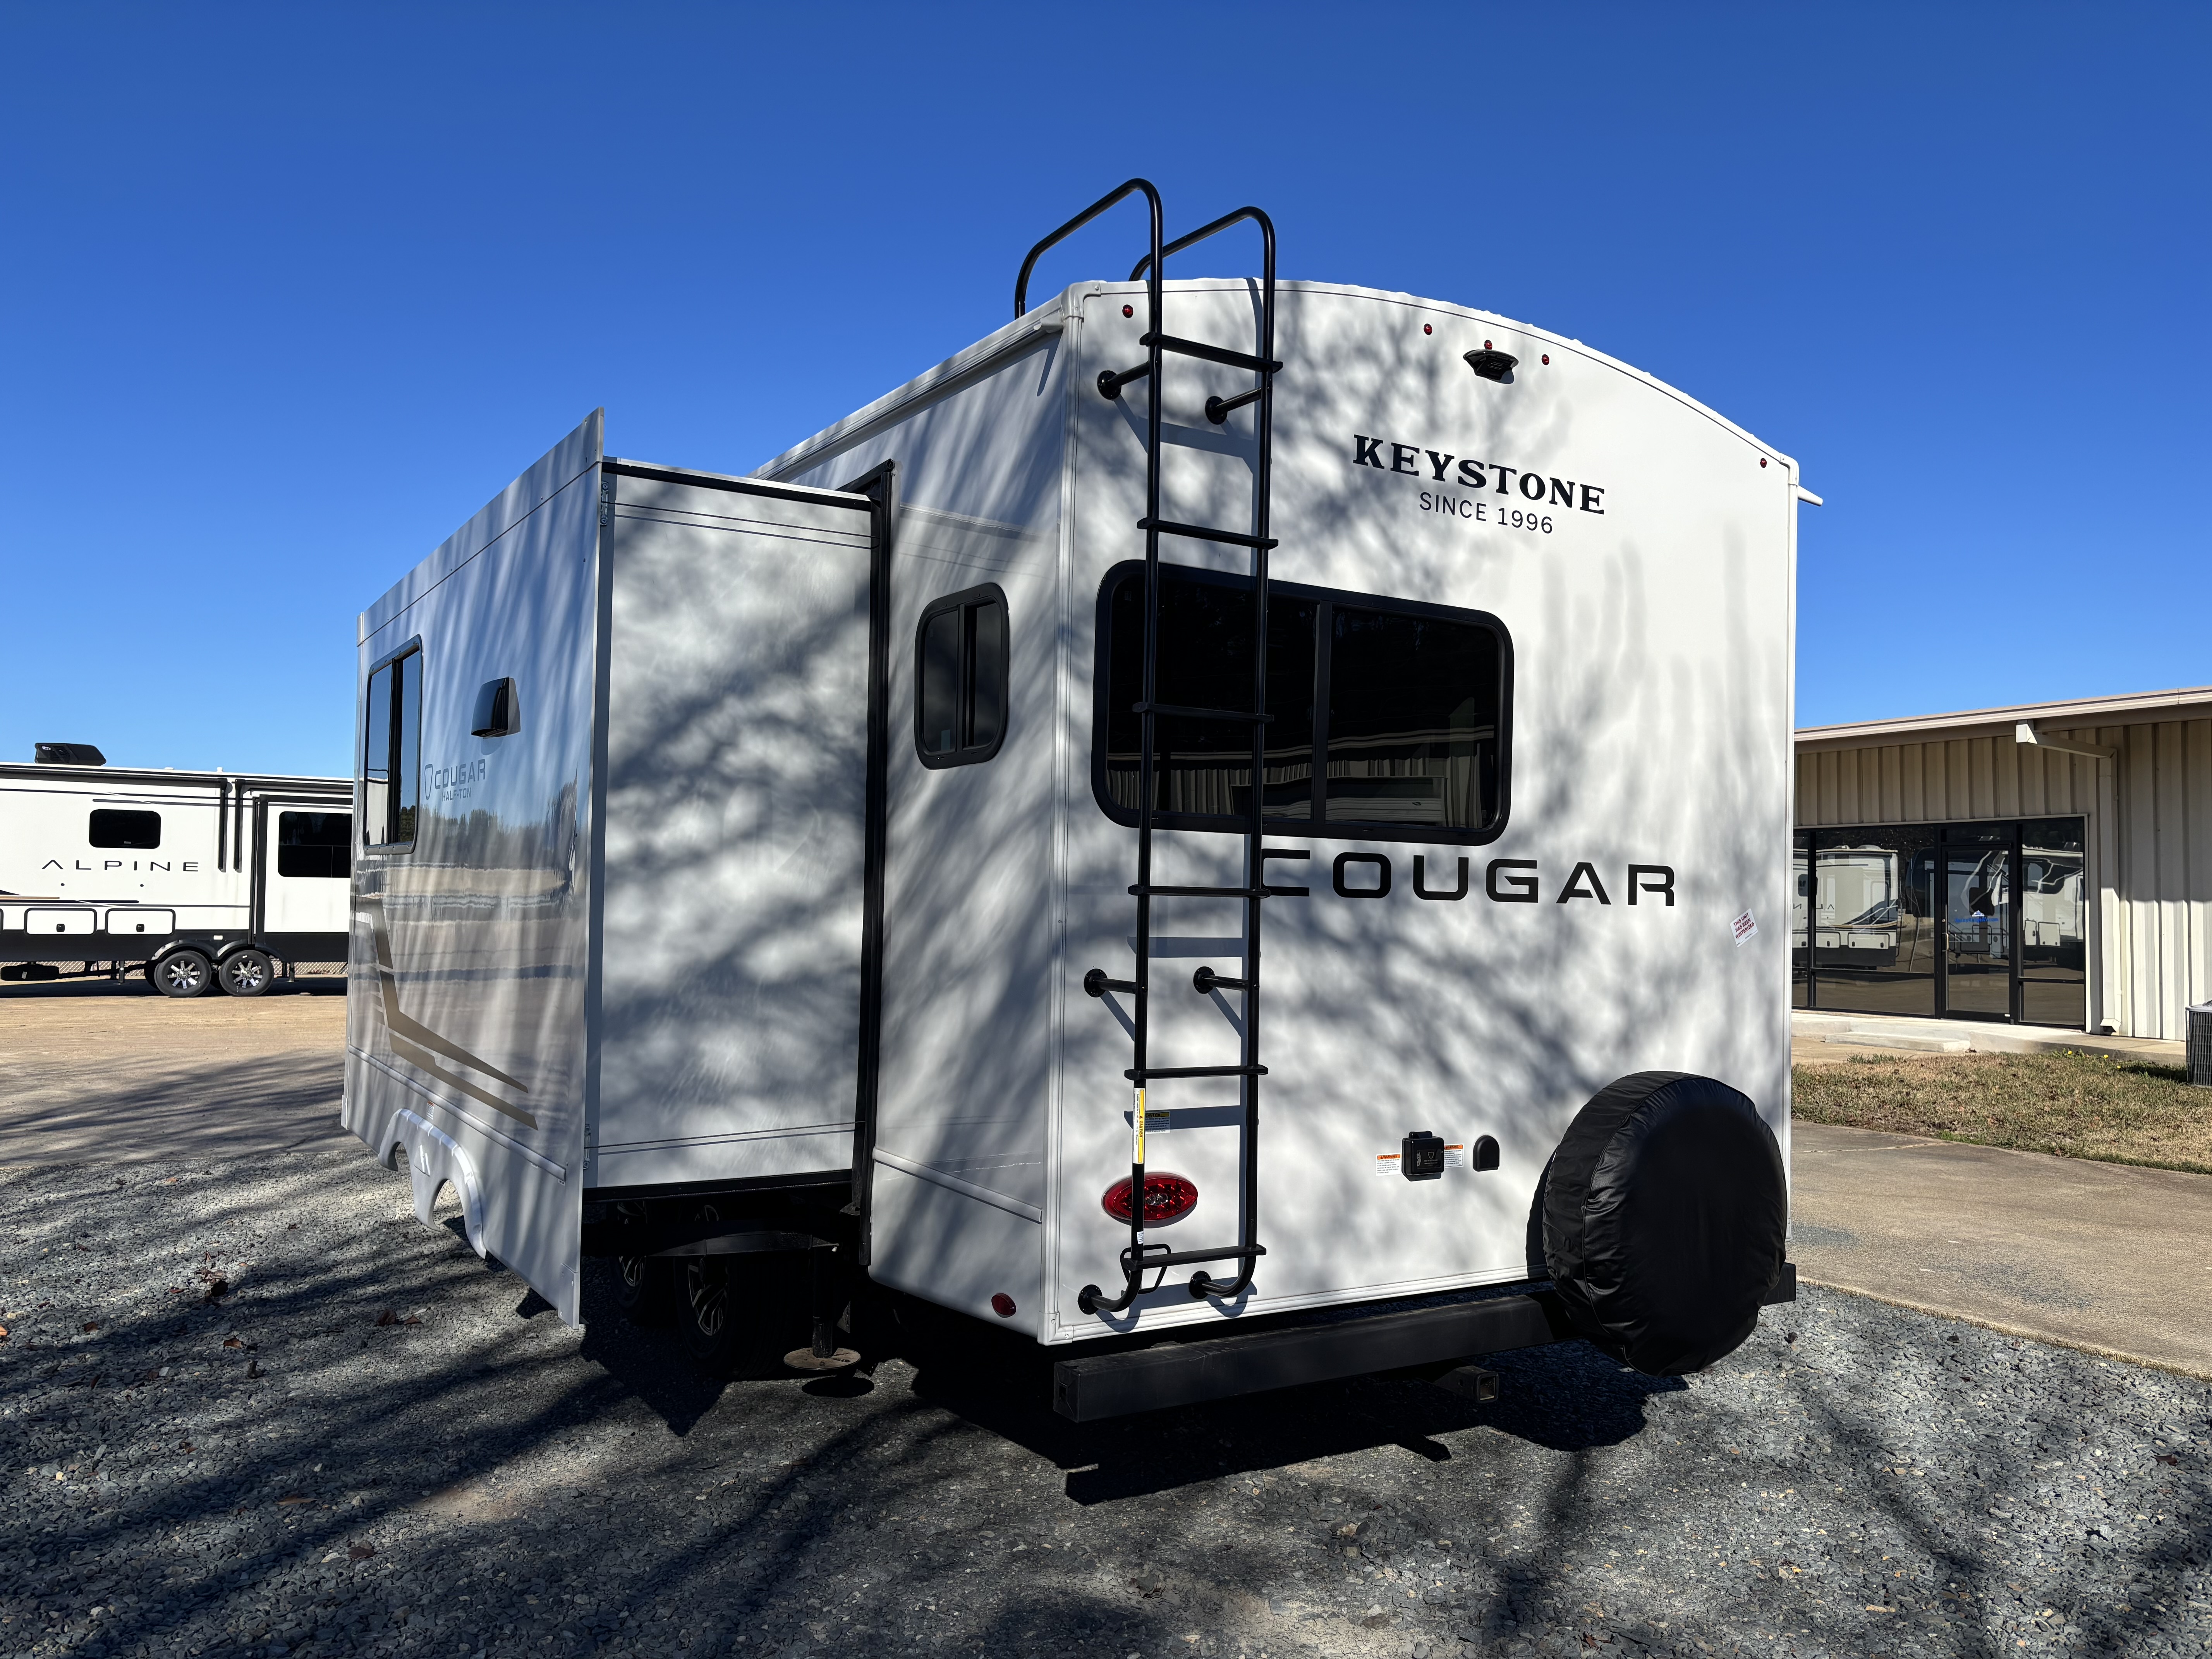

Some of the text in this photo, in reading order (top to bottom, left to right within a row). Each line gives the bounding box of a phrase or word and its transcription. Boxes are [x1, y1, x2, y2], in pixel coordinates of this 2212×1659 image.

[1353, 434, 1605, 515] KEYSTONE
[1419, 492, 1553, 534] SINCE 1996
[435, 759, 486, 790] COUGAR
[442, 787, 471, 802] HALF-TON
[42, 859, 199, 872] ALPINE
[1261, 848, 1674, 906] COUGAR
[1733, 912, 1749, 927] THIS UNIT
[1742, 918, 1751, 927] BEEN
[1735, 922, 1755, 939] WINTERIZED
